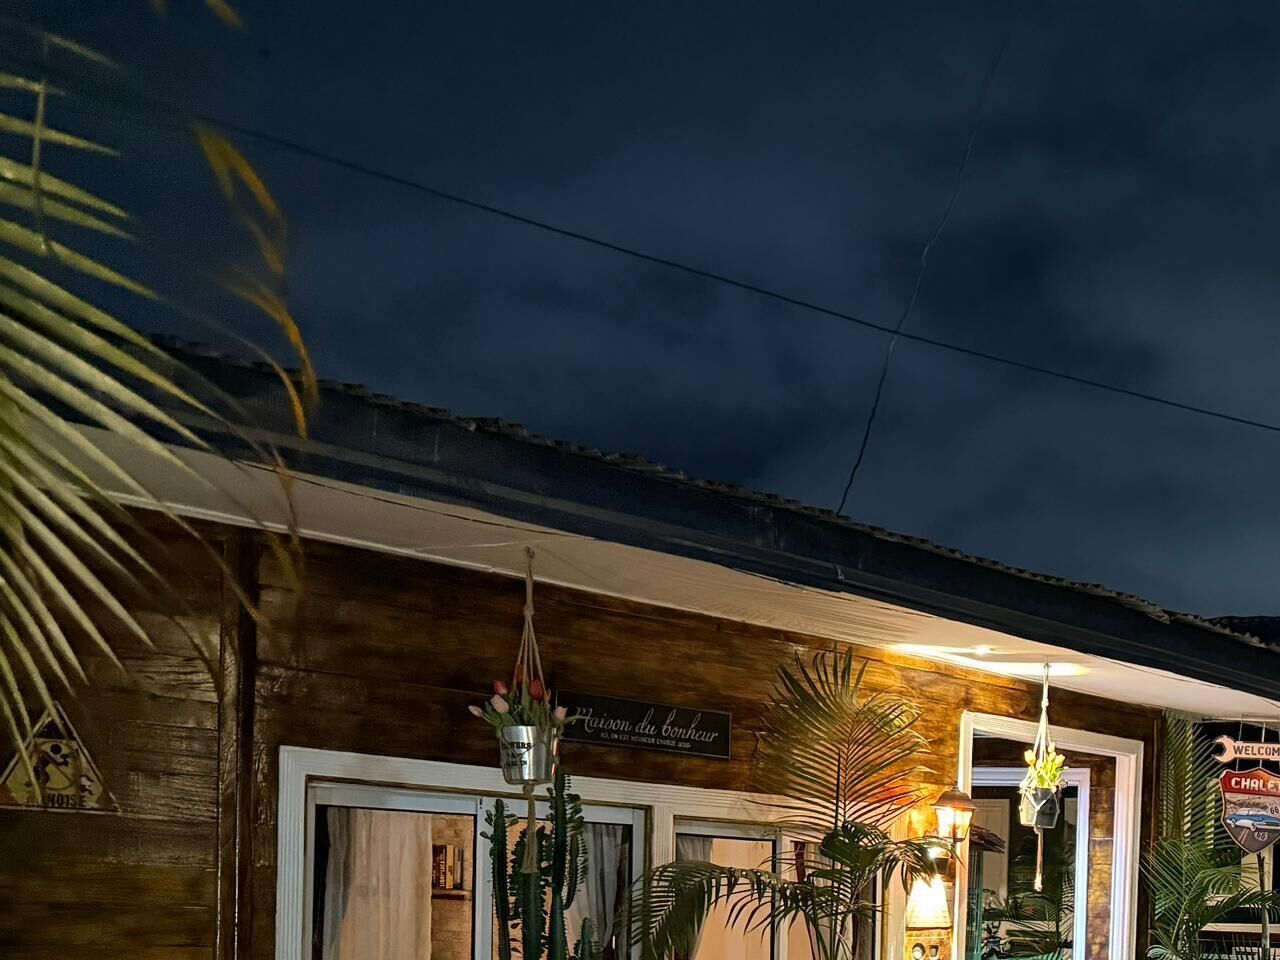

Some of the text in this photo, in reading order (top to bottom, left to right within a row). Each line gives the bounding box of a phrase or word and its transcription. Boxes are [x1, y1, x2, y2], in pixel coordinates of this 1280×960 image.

[571, 706, 719, 742] Maison du bonheur
[1270, 806, 1279, 815] 66
[1256, 832, 1265, 840] 66
